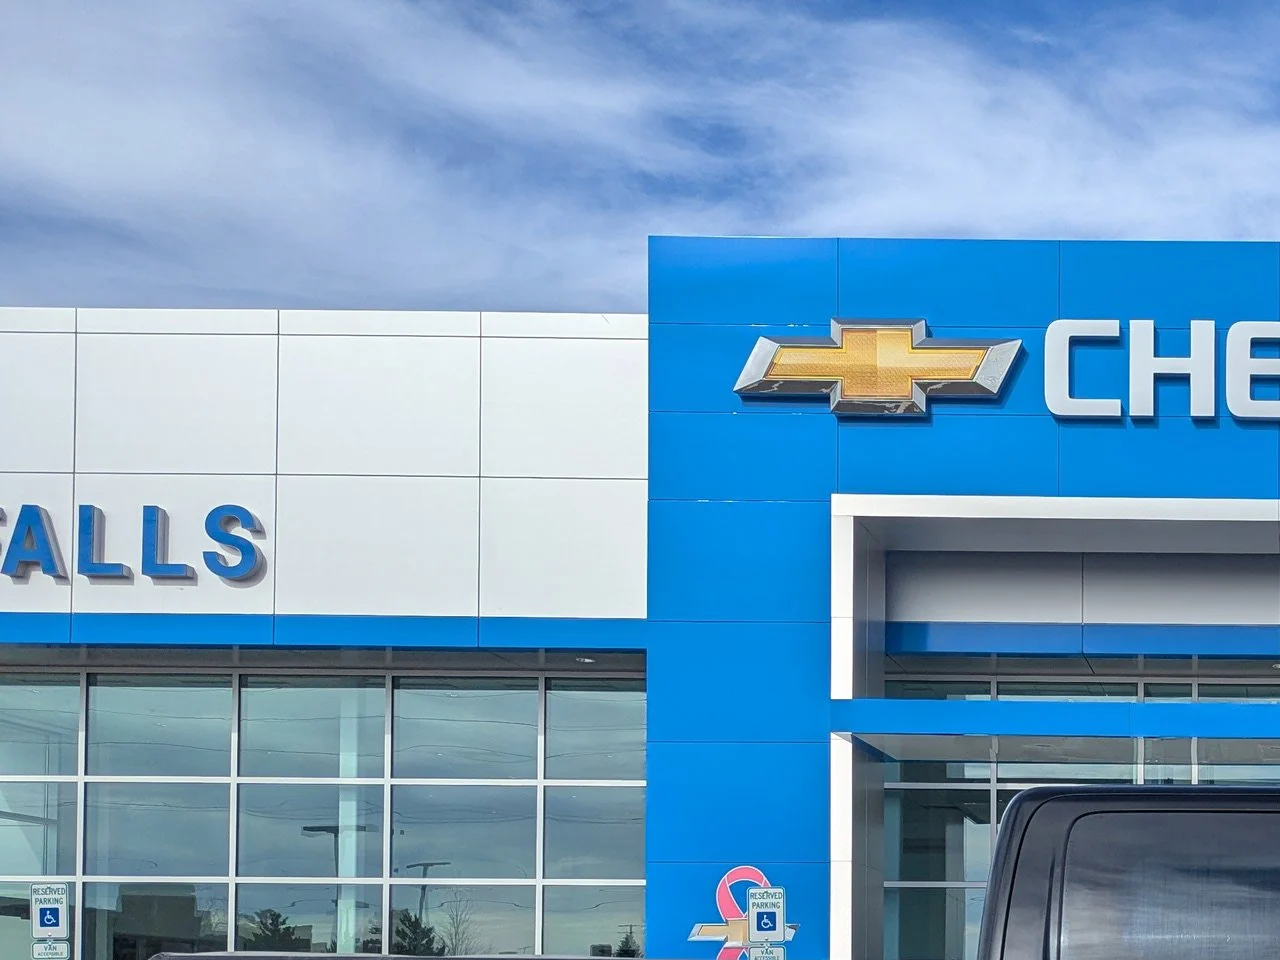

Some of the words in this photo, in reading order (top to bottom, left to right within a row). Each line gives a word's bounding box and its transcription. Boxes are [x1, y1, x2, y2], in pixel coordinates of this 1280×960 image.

[0, 504, 266, 581] ALLS
[33, 888, 65, 896] RESERVED
[750, 892, 783, 900] RESERVED
[751, 901, 780, 909] PARKING
